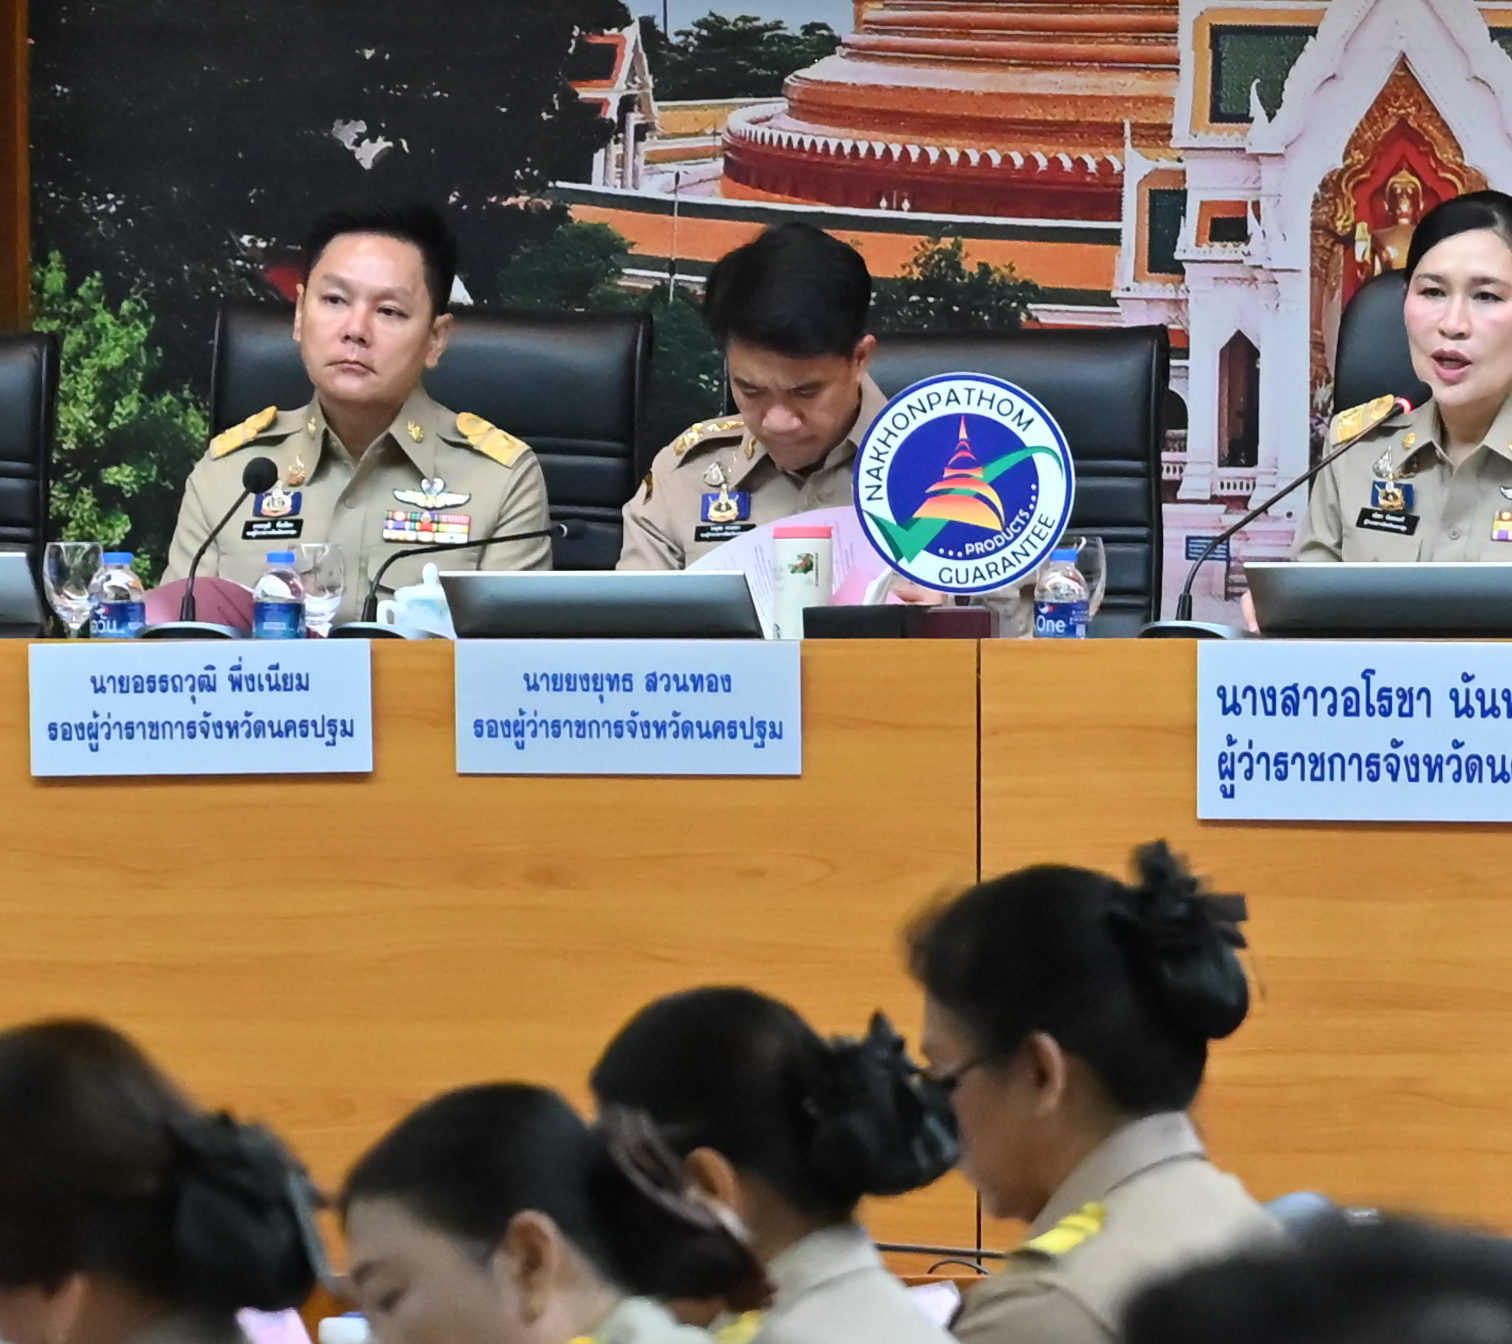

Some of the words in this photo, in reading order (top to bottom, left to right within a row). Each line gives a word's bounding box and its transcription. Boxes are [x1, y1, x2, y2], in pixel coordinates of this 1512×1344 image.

[864, 386, 1036, 503] NAKHONPATHOM
[937, 511, 1057, 586] GUARANTEE
[89, 664, 218, 705] นายอรรถวุฒิ
[227, 656, 311, 693] พึ่งเนียม
[523, 671, 634, 704] นายยงยุทธ
[644, 671, 733, 693] สวนทอง
[1216, 668, 1433, 719] นางสาวอโรชา
[47, 710, 355, 753] รองผู้ว่าราชการจังหวัดนครปฐม
[472, 707, 784, 751] รองผู้ว่าราชการจังหวัดนครปฐม
